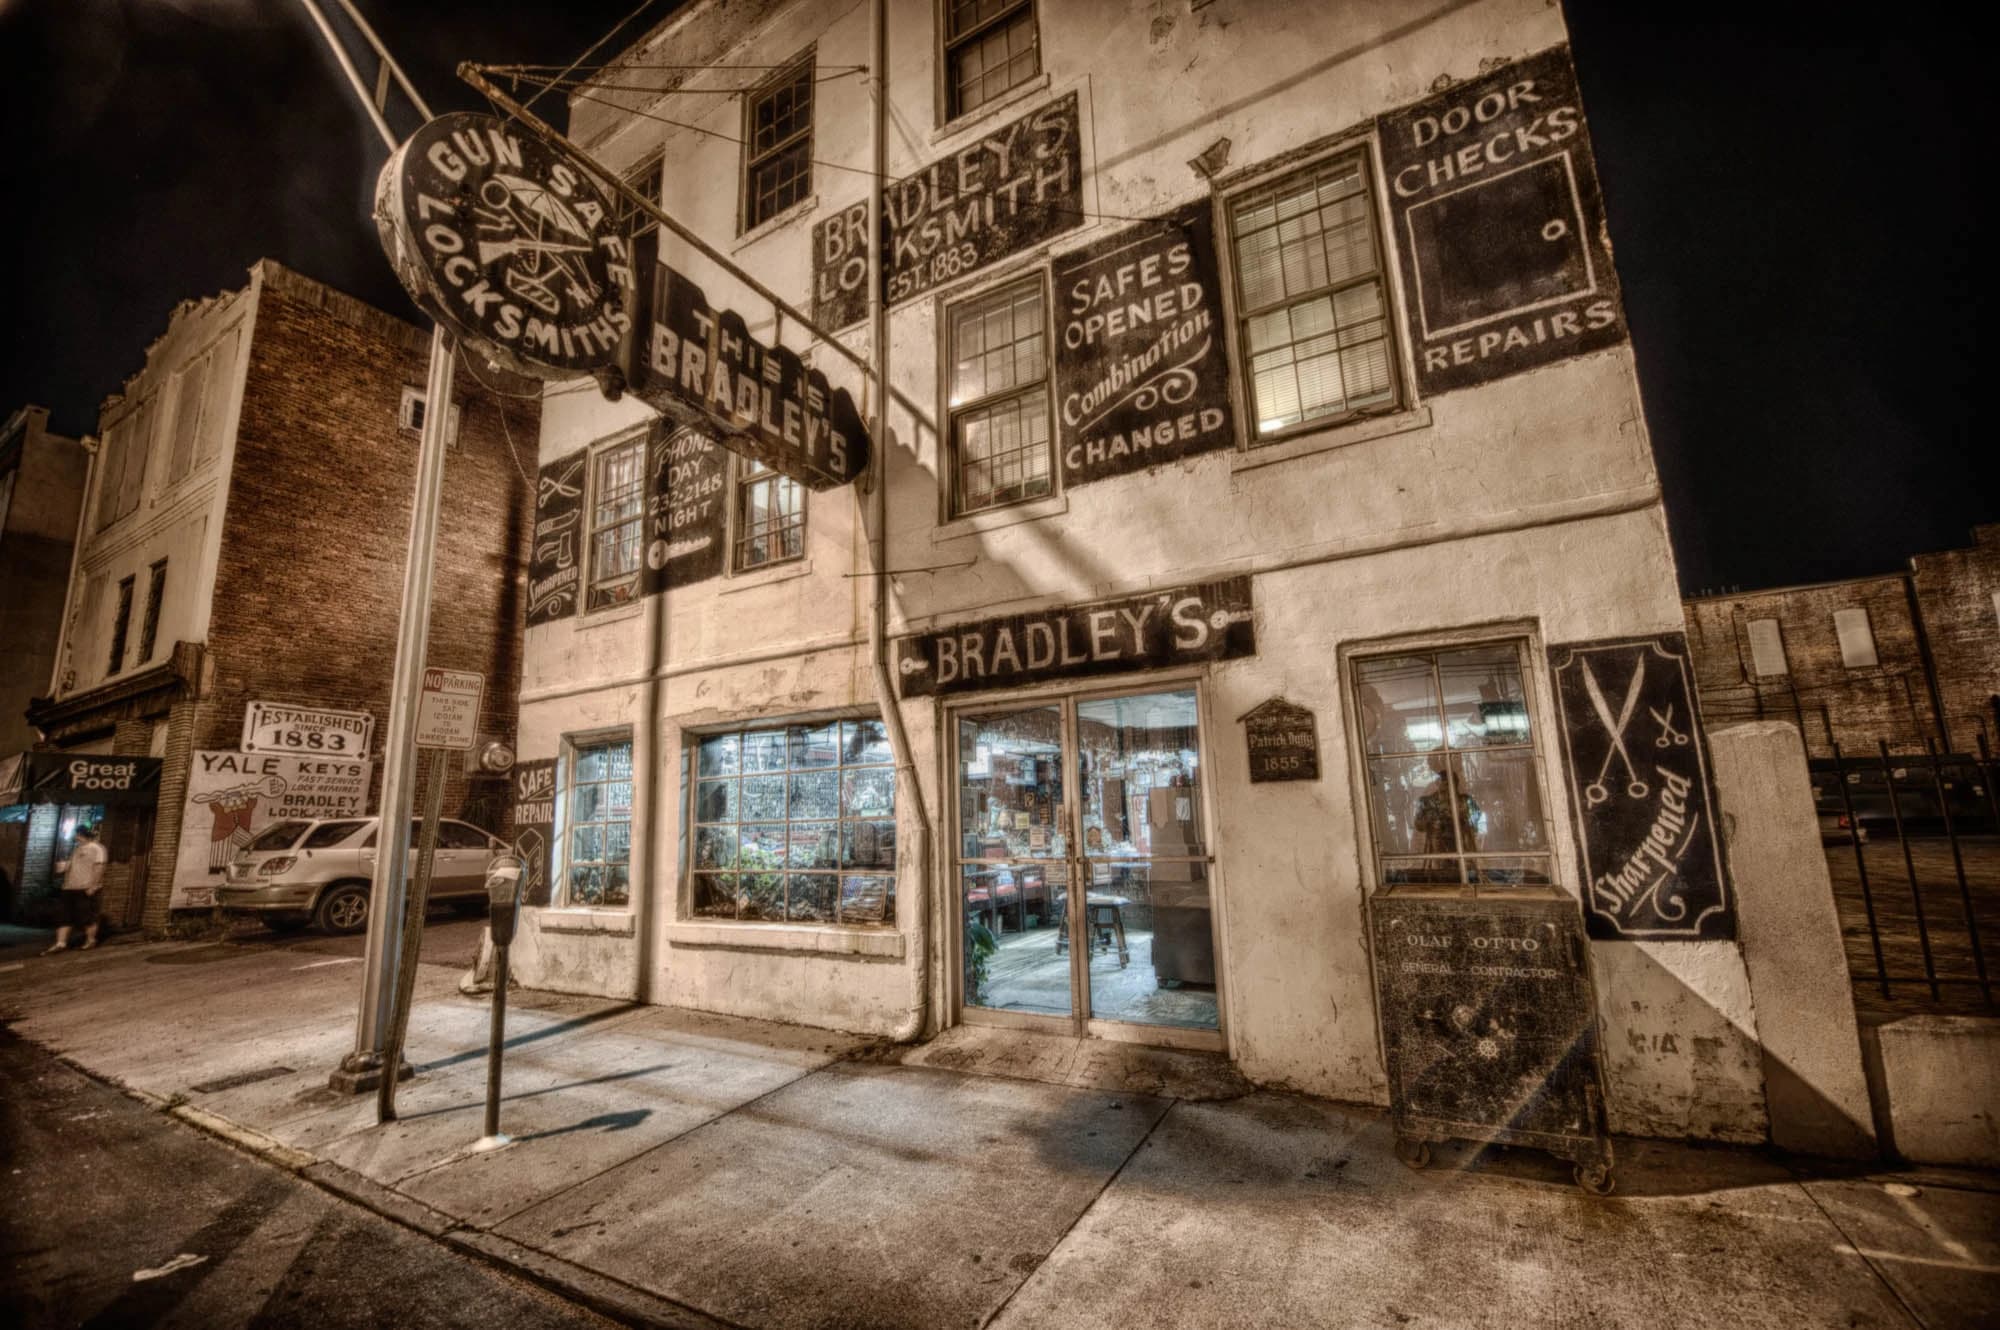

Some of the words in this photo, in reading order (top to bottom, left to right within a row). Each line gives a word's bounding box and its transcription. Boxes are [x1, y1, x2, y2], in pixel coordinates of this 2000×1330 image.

[1412, 80, 1542, 147] DOOR
[1394, 107, 1577, 197] CHECKS
[427, 128, 523, 181] GUN
[548, 164, 636, 290] SAFE
[820, 165, 1071, 302] LOKSMITH
[1071, 243, 1192, 316] SAFES
[1064, 283, 1203, 350] OPENED
[1424, 302, 1616, 372] REPAIRS
[692, 309, 782, 384] THIS
[797, 377, 824, 412] IS
[1063, 310, 1213, 425] Combination
[653, 321, 846, 476] BRADLEY'S
[1066, 408, 1225, 470] CHANGED
[655, 433, 713, 478] PHONE
[668, 456, 704, 487] DAY
[654, 500, 712, 536] NIGHT
[936, 596, 1209, 684] BRADLEY'S
[425, 673, 442, 688] NO
[443, 678, 480, 690] PARKING
[260, 710, 364, 735] ESTABLISHED
[294, 723, 326, 732] SINCE
[271, 730, 346, 751] 1883
[1249, 733, 1286, 749] Patrick
[69, 760, 136, 776] Great
[201, 754, 280, 775] YALE
[298, 763, 361, 776] KEYS
[1264, 756, 1299, 771] 1855
[71, 775, 130, 789] Food
[291, 784, 315, 792] LOCK
[318, 785, 360, 793] REPAIRED
[297, 775, 323, 783] FAST
[325, 777, 362, 785] SERVICE
[519, 767, 553, 800] SAFE
[269, 808, 308, 817] LOCK
[283, 795, 360, 807] BRADLEY
[515, 802, 553, 825] REPAIR
[1594, 765, 1691, 915] Sharpened
[1407, 934, 1452, 947] OLAF
[1473, 936, 1538, 951] OTTO
[1401, 961, 1455, 974] GENERAL
[1471, 965, 1558, 979] CONTRACTOR
